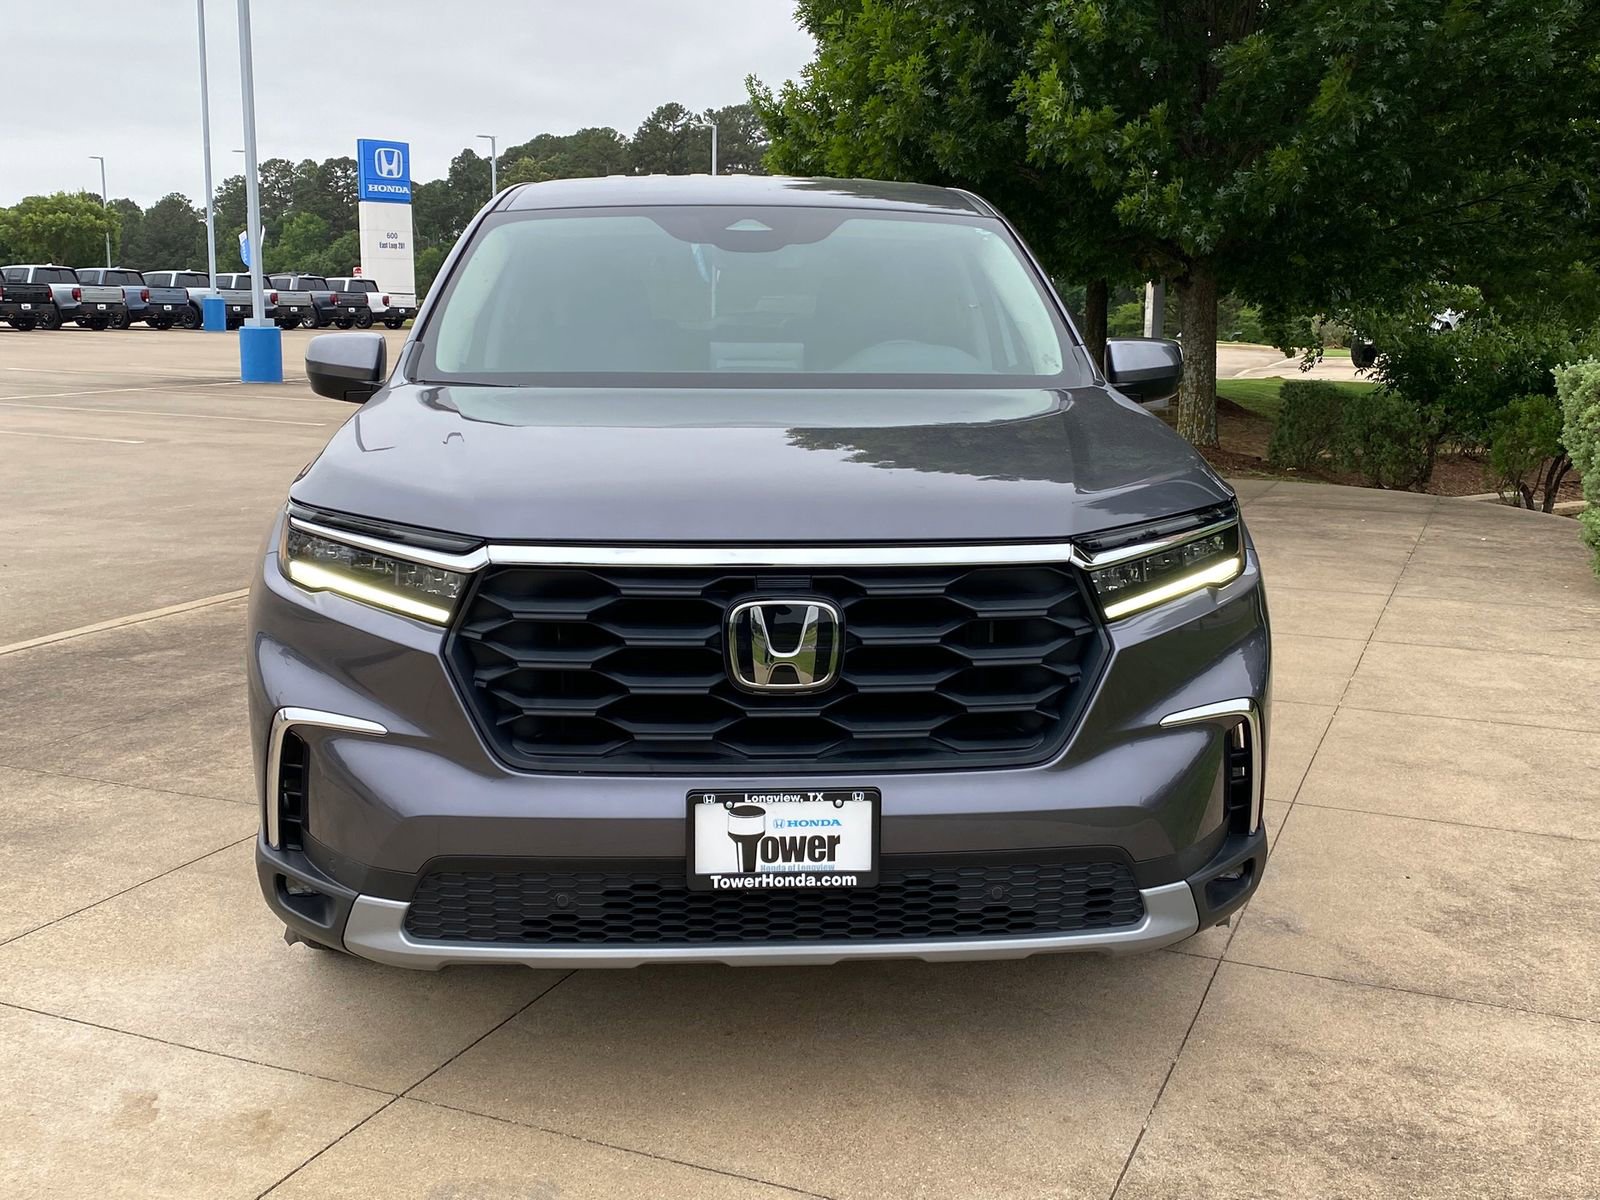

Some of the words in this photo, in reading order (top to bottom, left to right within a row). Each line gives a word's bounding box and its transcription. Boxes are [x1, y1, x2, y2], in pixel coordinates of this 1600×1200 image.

[368, 184, 410, 193] HONDA
[744, 793, 804, 804] Longview,
[808, 793, 824, 802] TX
[786, 818, 842, 828] HONDA
[760, 864, 786, 872] Honda
[710, 874, 858, 889] TowerHonda.com
